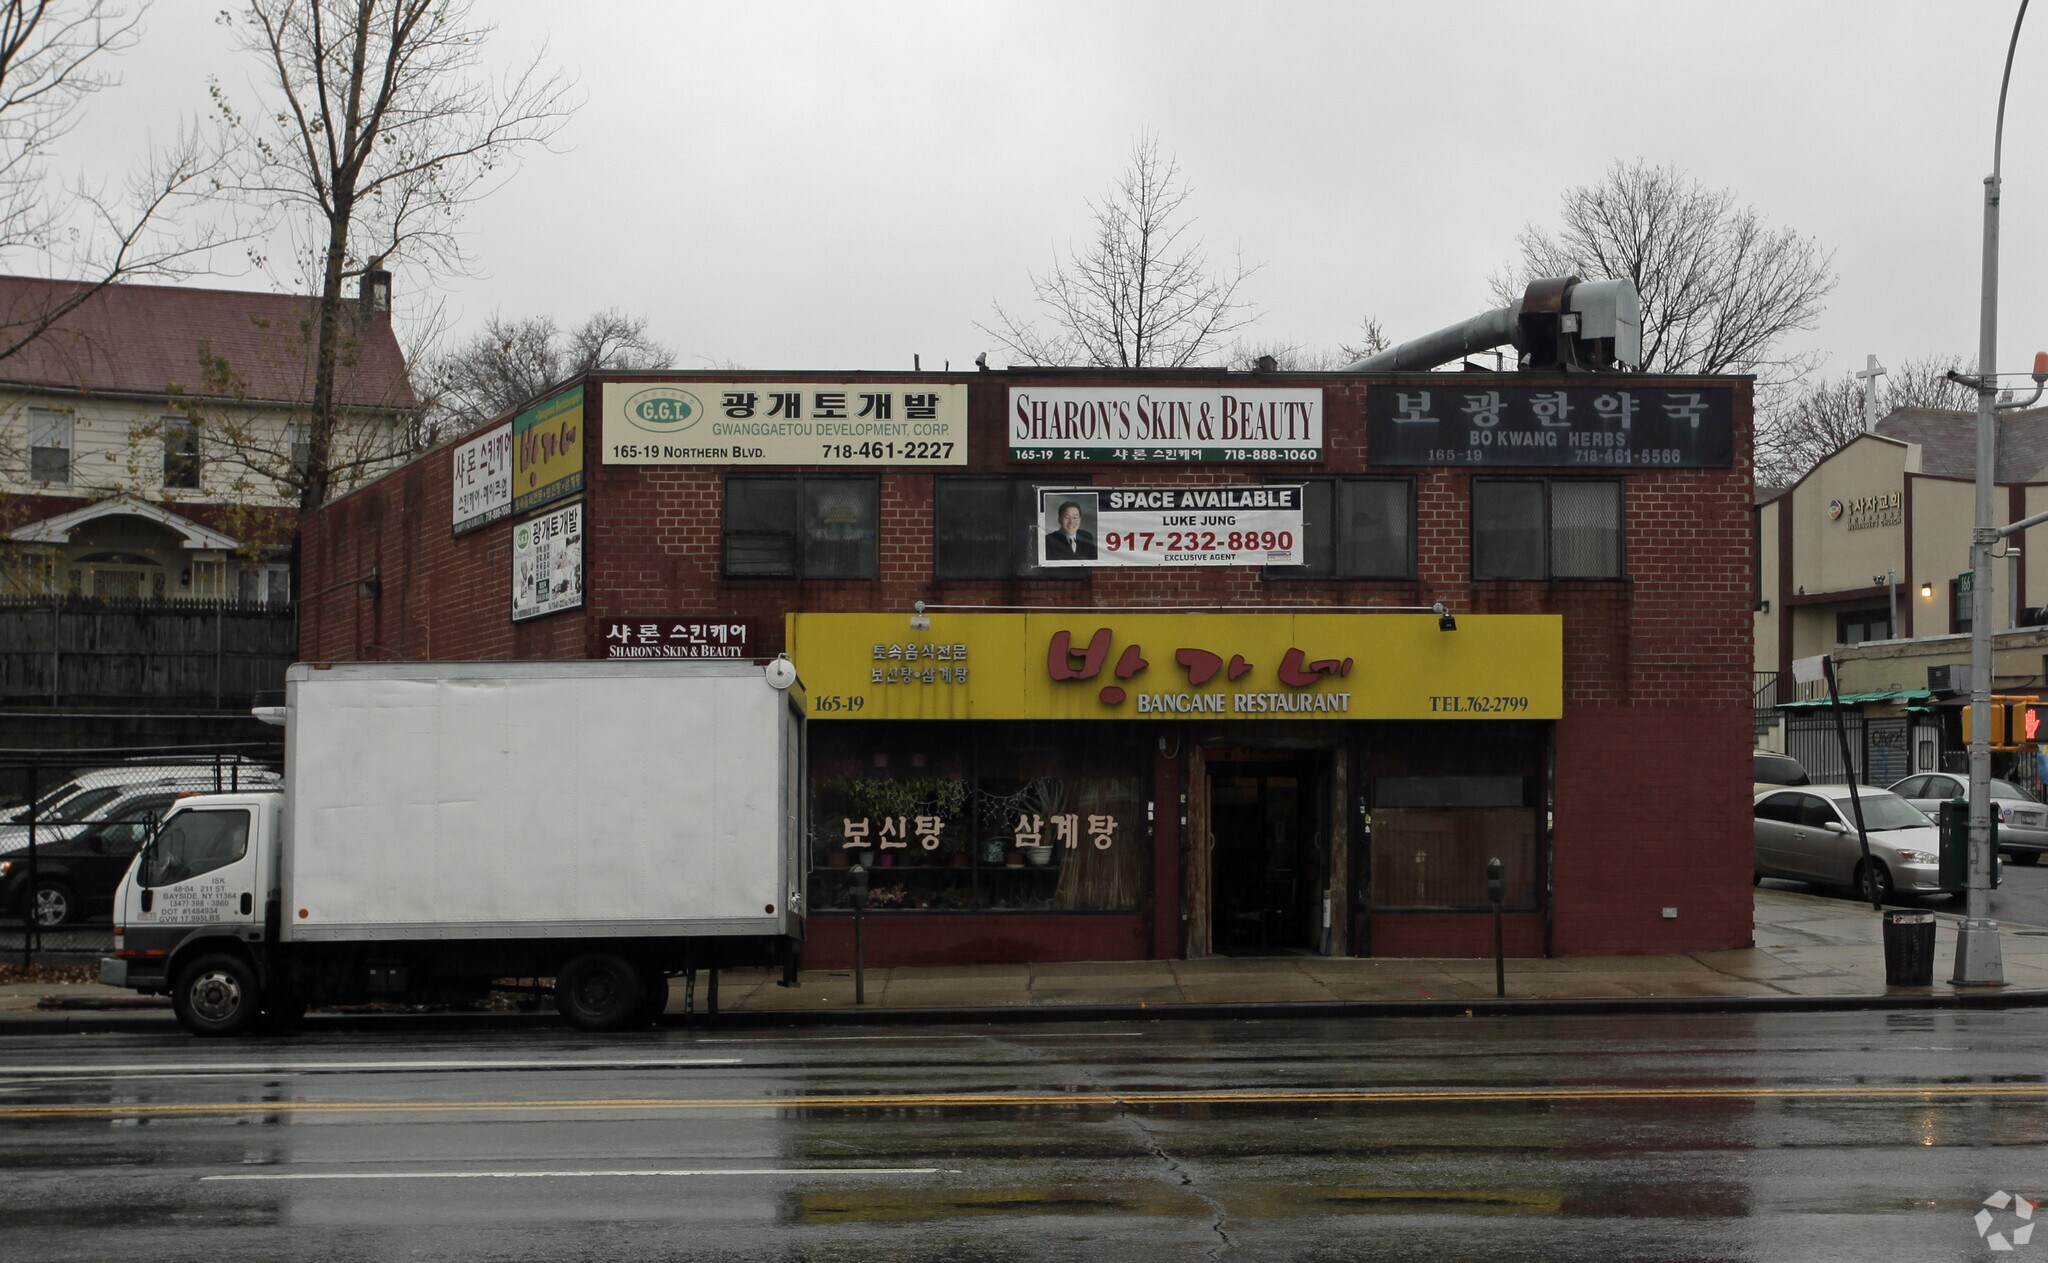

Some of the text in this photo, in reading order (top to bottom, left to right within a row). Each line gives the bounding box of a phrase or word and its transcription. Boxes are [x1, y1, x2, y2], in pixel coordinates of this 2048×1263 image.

[722, 392, 940, 420] 광개토개발
[1392, 390, 1709, 429] 보광한약국
[1016, 393, 1314, 440] SHARON'S SKIN & BEAUTY
[712, 423, 949, 437] GWANGGAETOU DEVELOPMENT, CORP.
[1470, 431, 1626, 446] BO KWANG HERBS
[480, 430, 512, 477] 스킨케어
[613, 445, 766, 458] 165-19 NORTHERN BLVD.
[822, 441, 955, 459] 718-461-2227
[1015, 450, 1090, 460] 165-19 2 FL.
[1153, 449, 1202, 460] 스킨케어
[1224, 449, 1317, 460] 718-888-1060
[1428, 450, 1482, 461] 165-19
[1575, 449, 1681, 463] 718-461-5566
[1110, 490, 1292, 508] SPACE AVAILABLE
[533, 508, 578, 545] 광개토개발
[1162, 516, 1236, 526] LUKE JUNG
[1105, 531, 1293, 551] 917-232-8890
[1164, 553, 1236, 561] EXCLUSIVE AGENT
[670, 624, 746, 643] 스킨케어
[609, 645, 742, 657] SHARON'S SKIN & BEAUTY
[872, 643, 967, 660] 토속음식전문
[814, 695, 864, 711] 165-19
[1138, 693, 1351, 712] BANGANE RESTAURANT
[842, 815, 945, 850] 보신탕
[1014, 814, 1118, 850] 삼계탕
[159, 915, 178, 923] GVW
